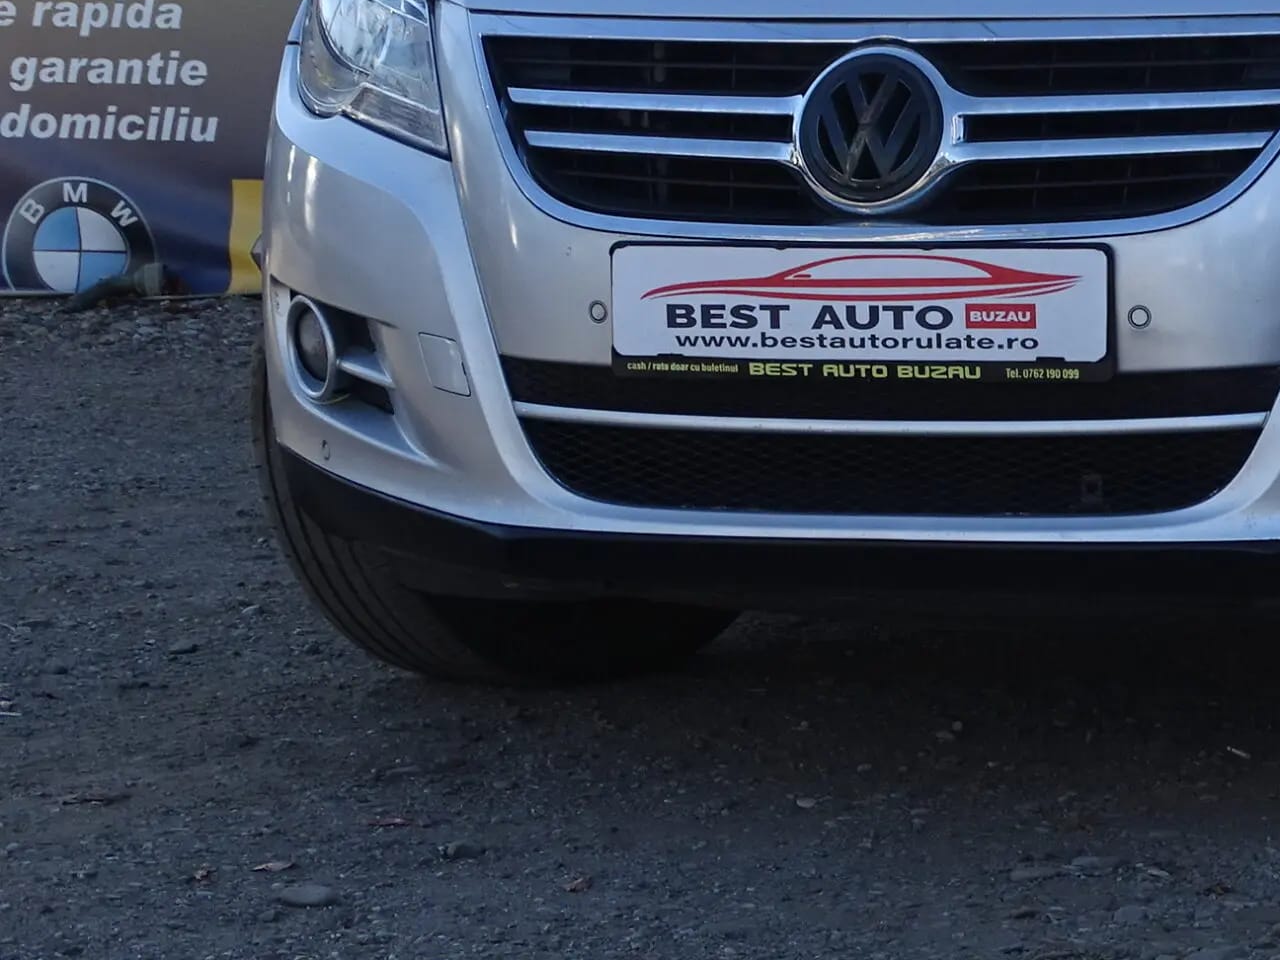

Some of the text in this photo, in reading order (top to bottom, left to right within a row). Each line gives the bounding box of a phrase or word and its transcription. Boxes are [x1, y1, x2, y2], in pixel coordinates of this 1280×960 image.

[9, 50, 209, 92] garantie
[0, 103, 219, 142] domiciliu
[19, 182, 138, 228] BMW
[666, 303, 1031, 331] BEST AUTO BUZAU
[675, 332, 1040, 350] www.bestautorulate.ro
[627, 361, 646, 371] cash
[670, 362, 688, 372] doar
[690, 364, 700, 372] cu
[701, 362, 739, 373] buletinul
[749, 362, 981, 379] BEST AUTO BUZAU
[1006, 368, 1021, 378] Tel.
